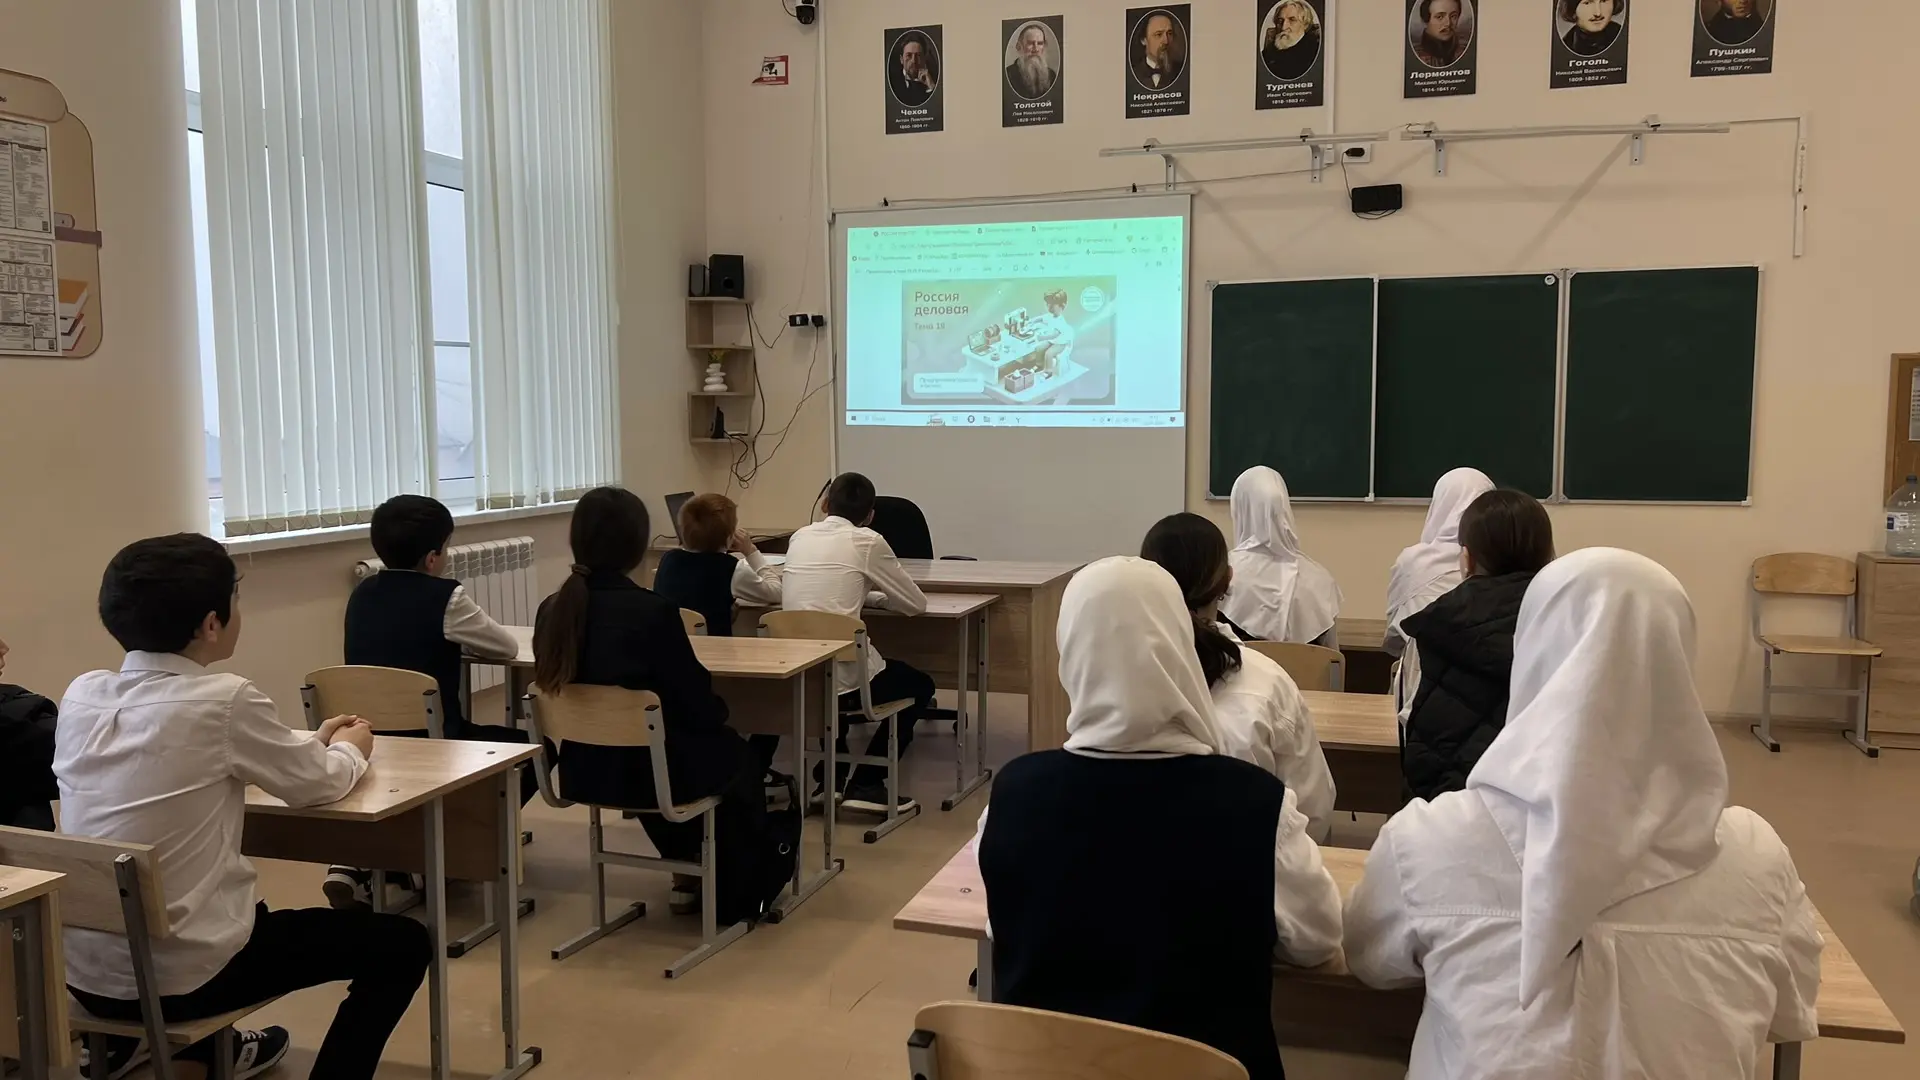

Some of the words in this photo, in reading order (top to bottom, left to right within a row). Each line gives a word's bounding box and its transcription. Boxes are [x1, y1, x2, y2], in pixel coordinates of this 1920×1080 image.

[1709, 48, 1756, 57] Пушкин
[1569, 59, 1609, 67] Гоголь
[1410, 69, 1471, 79] Лермонтов
[1266, 82, 1313, 91] Тургенев
[1133, 92, 1182, 101] Некрасов
[1013, 100, 1052, 109] Толстой
[914, 291, 960, 303] Россия
[914, 305, 969, 317] деловая
[914, 322, 933, 331] Тема
